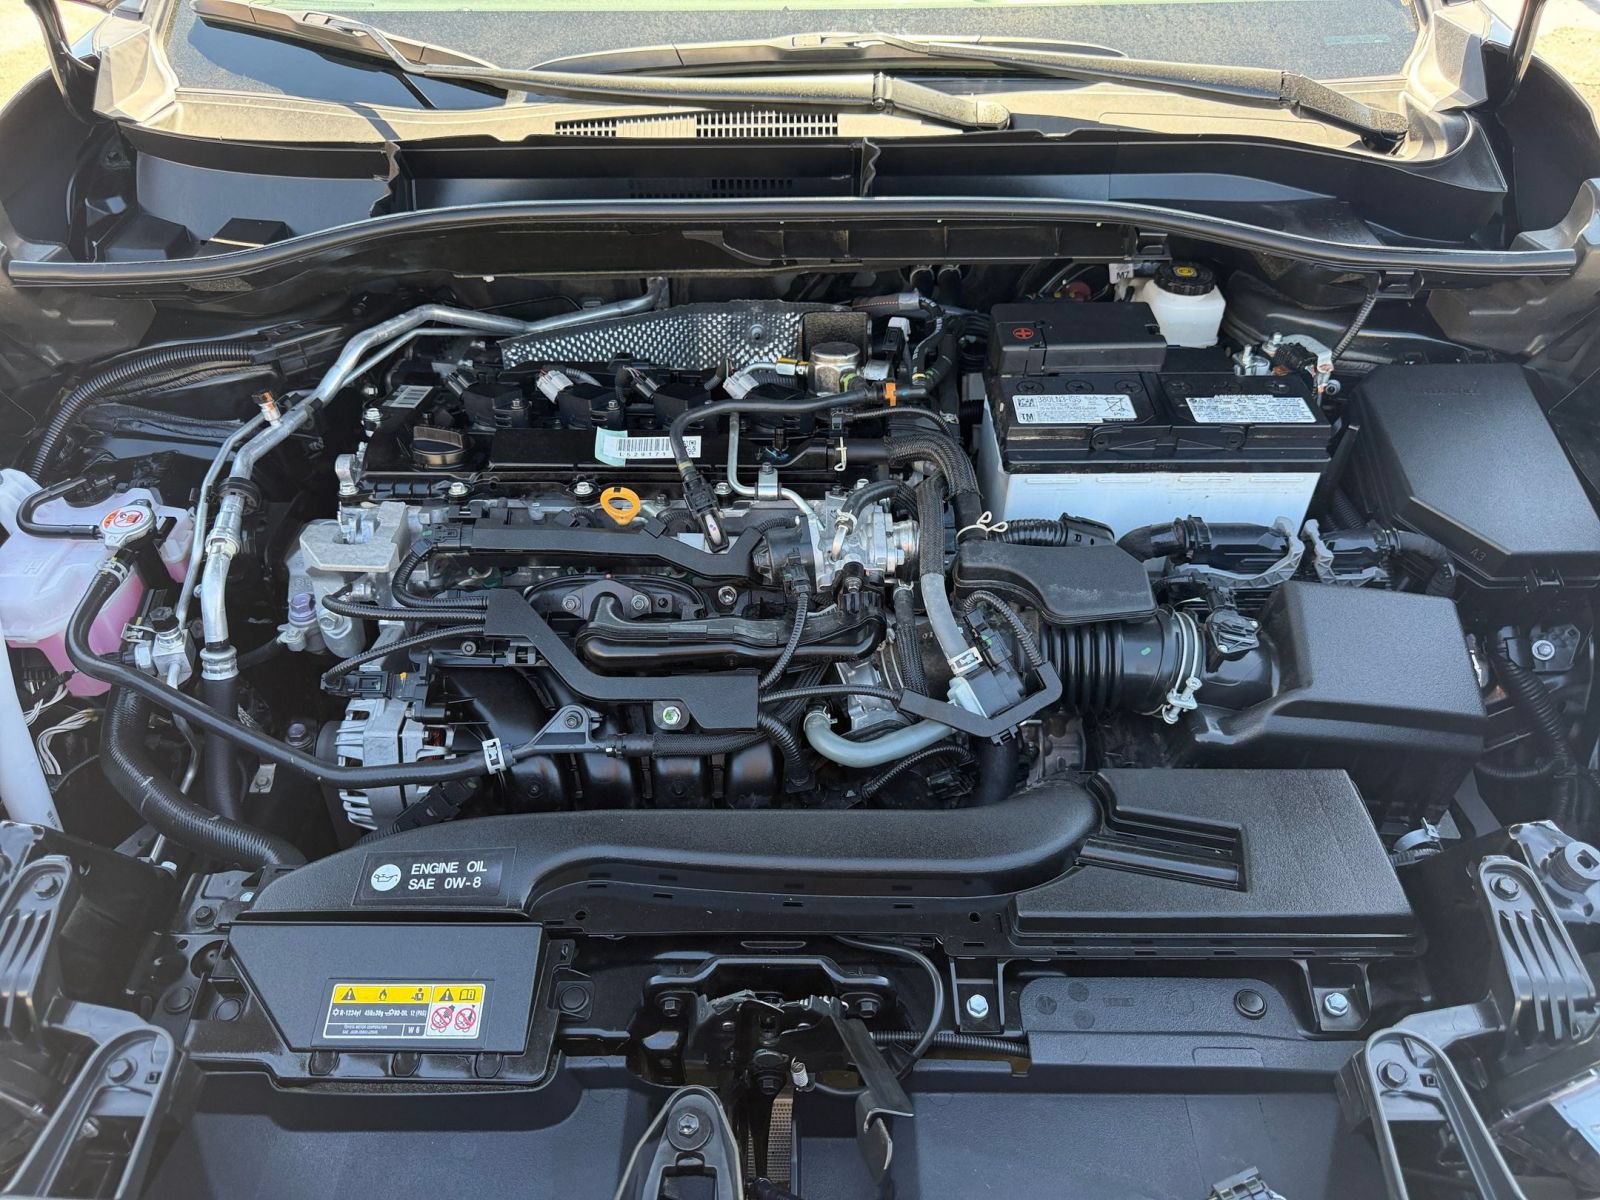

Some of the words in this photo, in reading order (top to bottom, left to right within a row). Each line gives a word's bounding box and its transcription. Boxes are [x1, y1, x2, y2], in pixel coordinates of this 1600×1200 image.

[1116, 271, 1130, 280] M7
[411, 862, 459, 875] ENGINE
[466, 860, 488, 873] OIL
[408, 878, 436, 890] SAE
[444, 877, 482, 889] 0W-8
